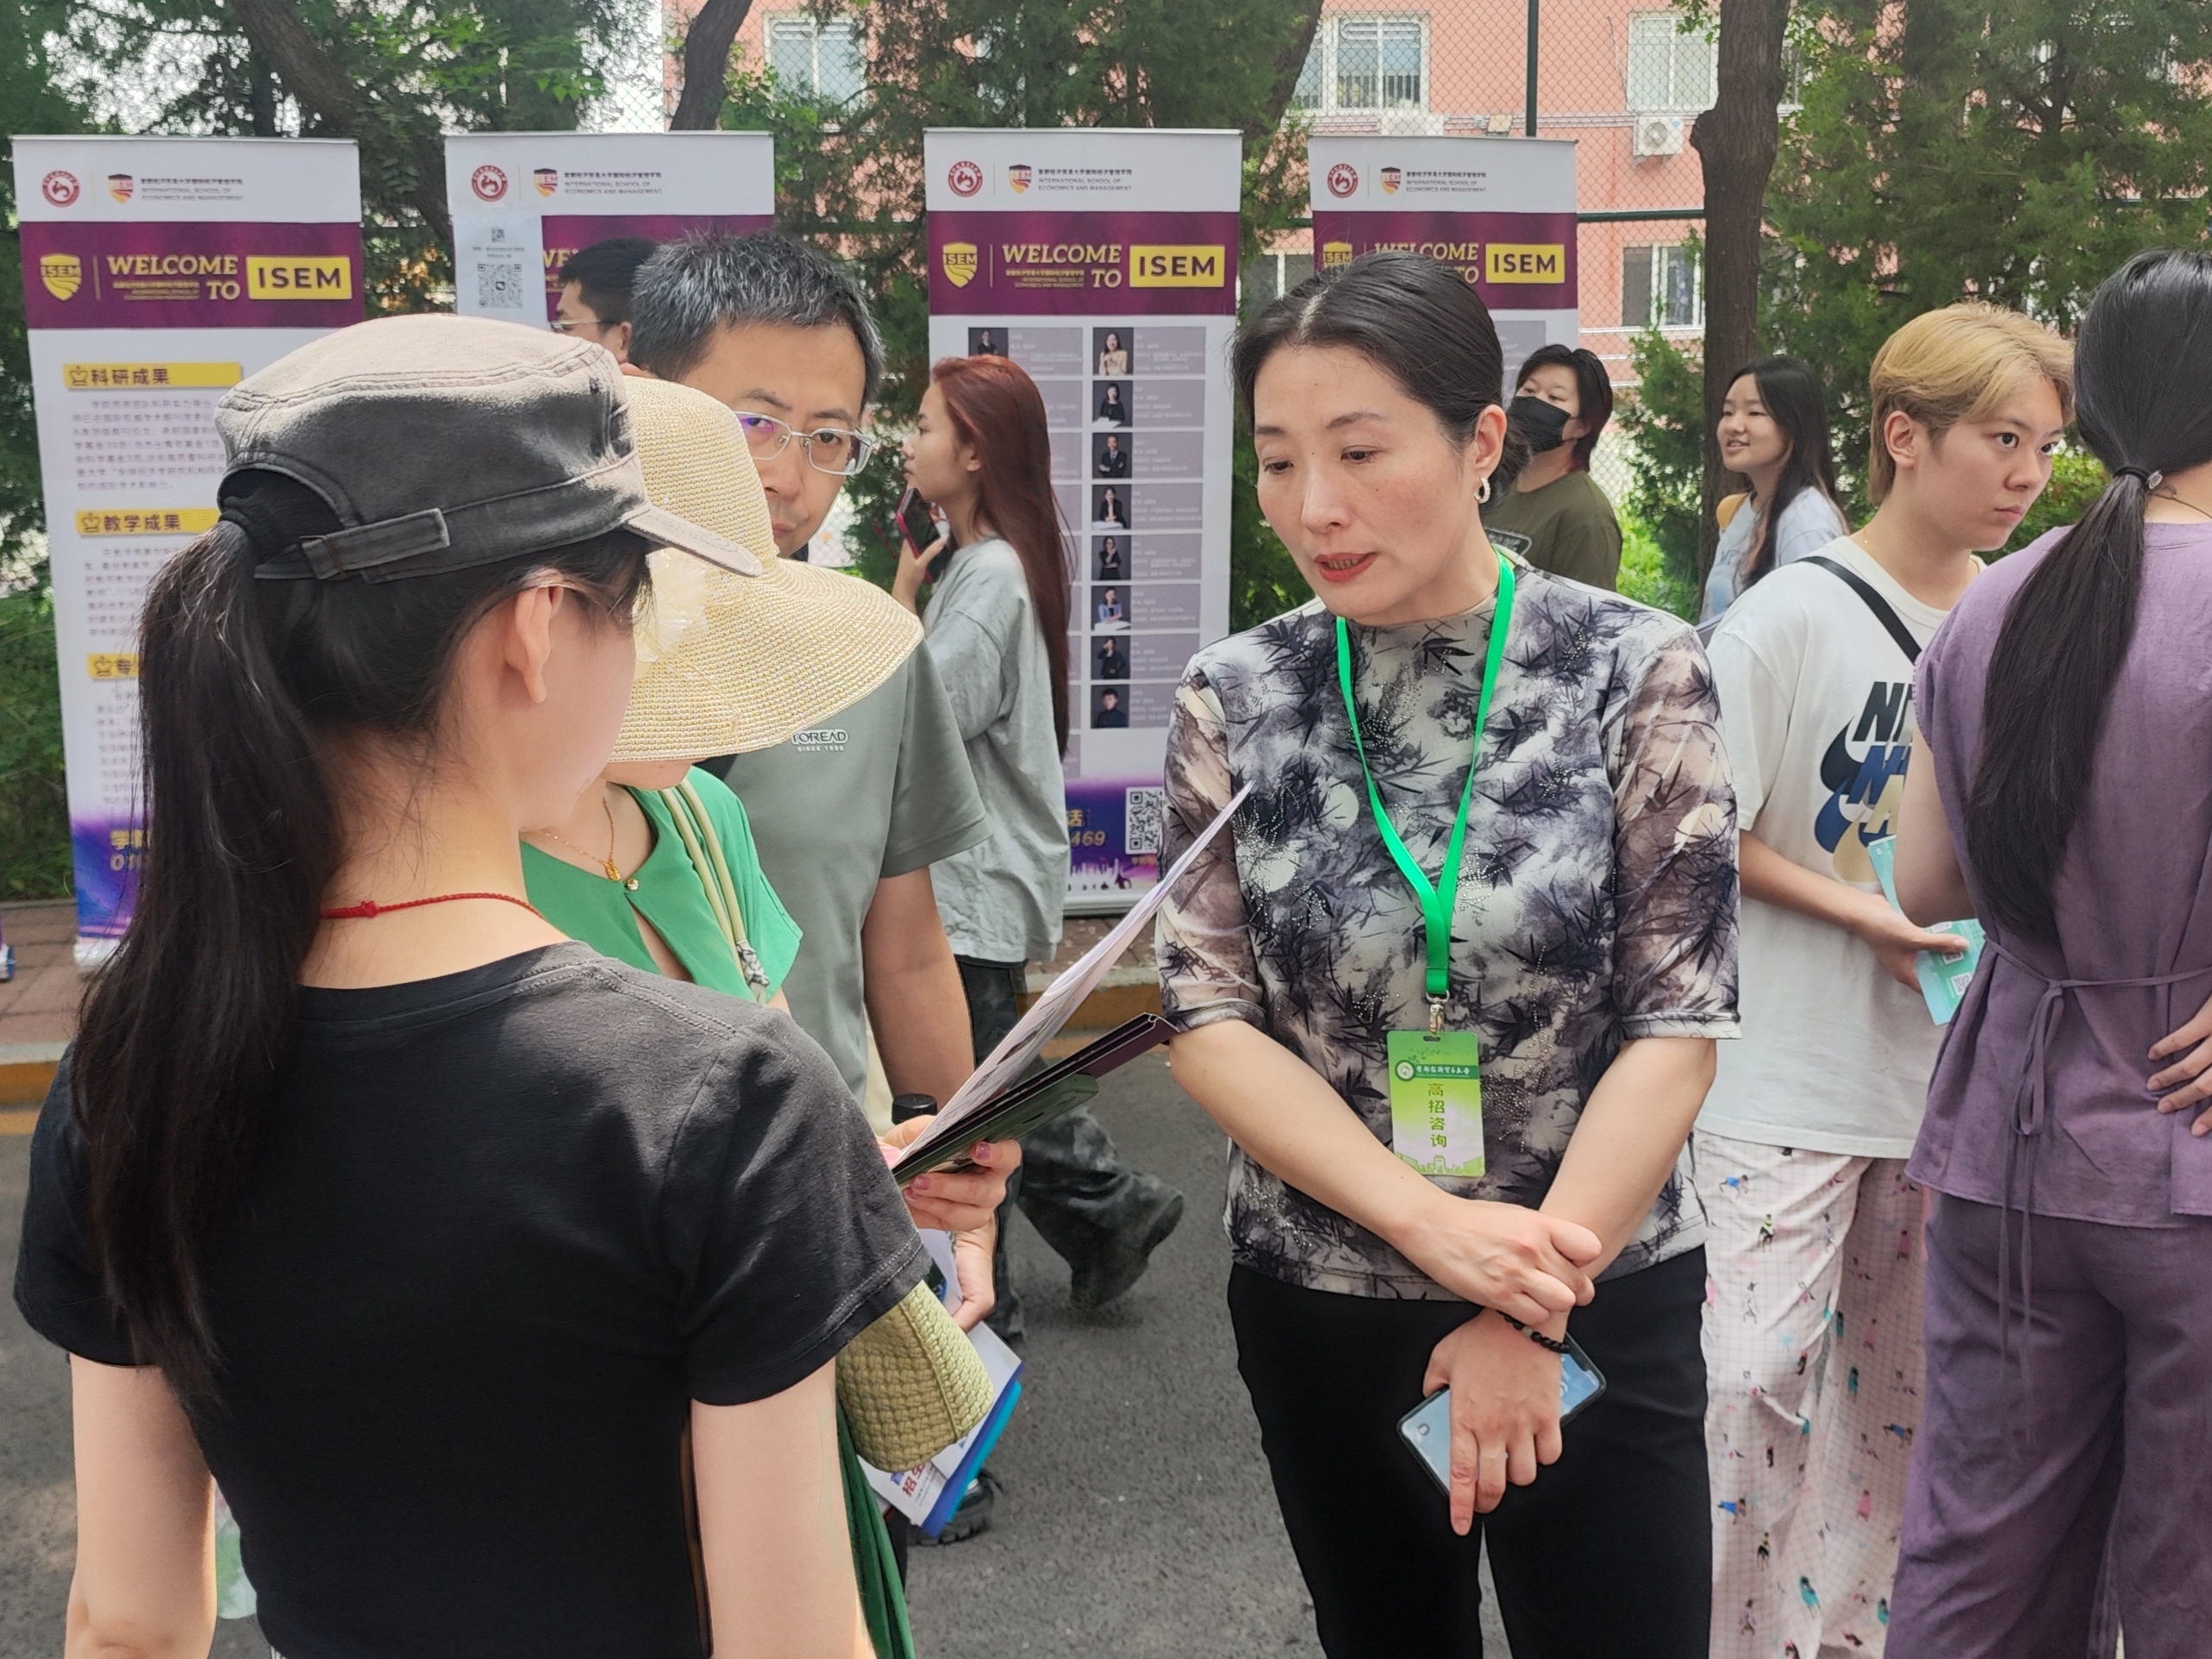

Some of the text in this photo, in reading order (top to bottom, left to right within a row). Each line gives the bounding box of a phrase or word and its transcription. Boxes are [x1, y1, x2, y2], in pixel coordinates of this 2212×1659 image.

[943, 254, 978, 264] ISEM
[1003, 244, 1122, 264] WELCOME
[1323, 252, 1353, 263] ISEM
[1494, 254, 1556, 273] ISEM
[41, 266, 81, 277] ISEM
[107, 255, 239, 275] WELCOME
[1139, 256, 1215, 277] ISEM
[258, 267, 341, 289] ISEM
[1091, 268, 1122, 288] TO
[205, 281, 241, 300] TO
[91, 368, 170, 385] 科研成果
[103, 514, 182, 532] 教学成果
[1428, 1083, 1447, 1148] 高招咨询
